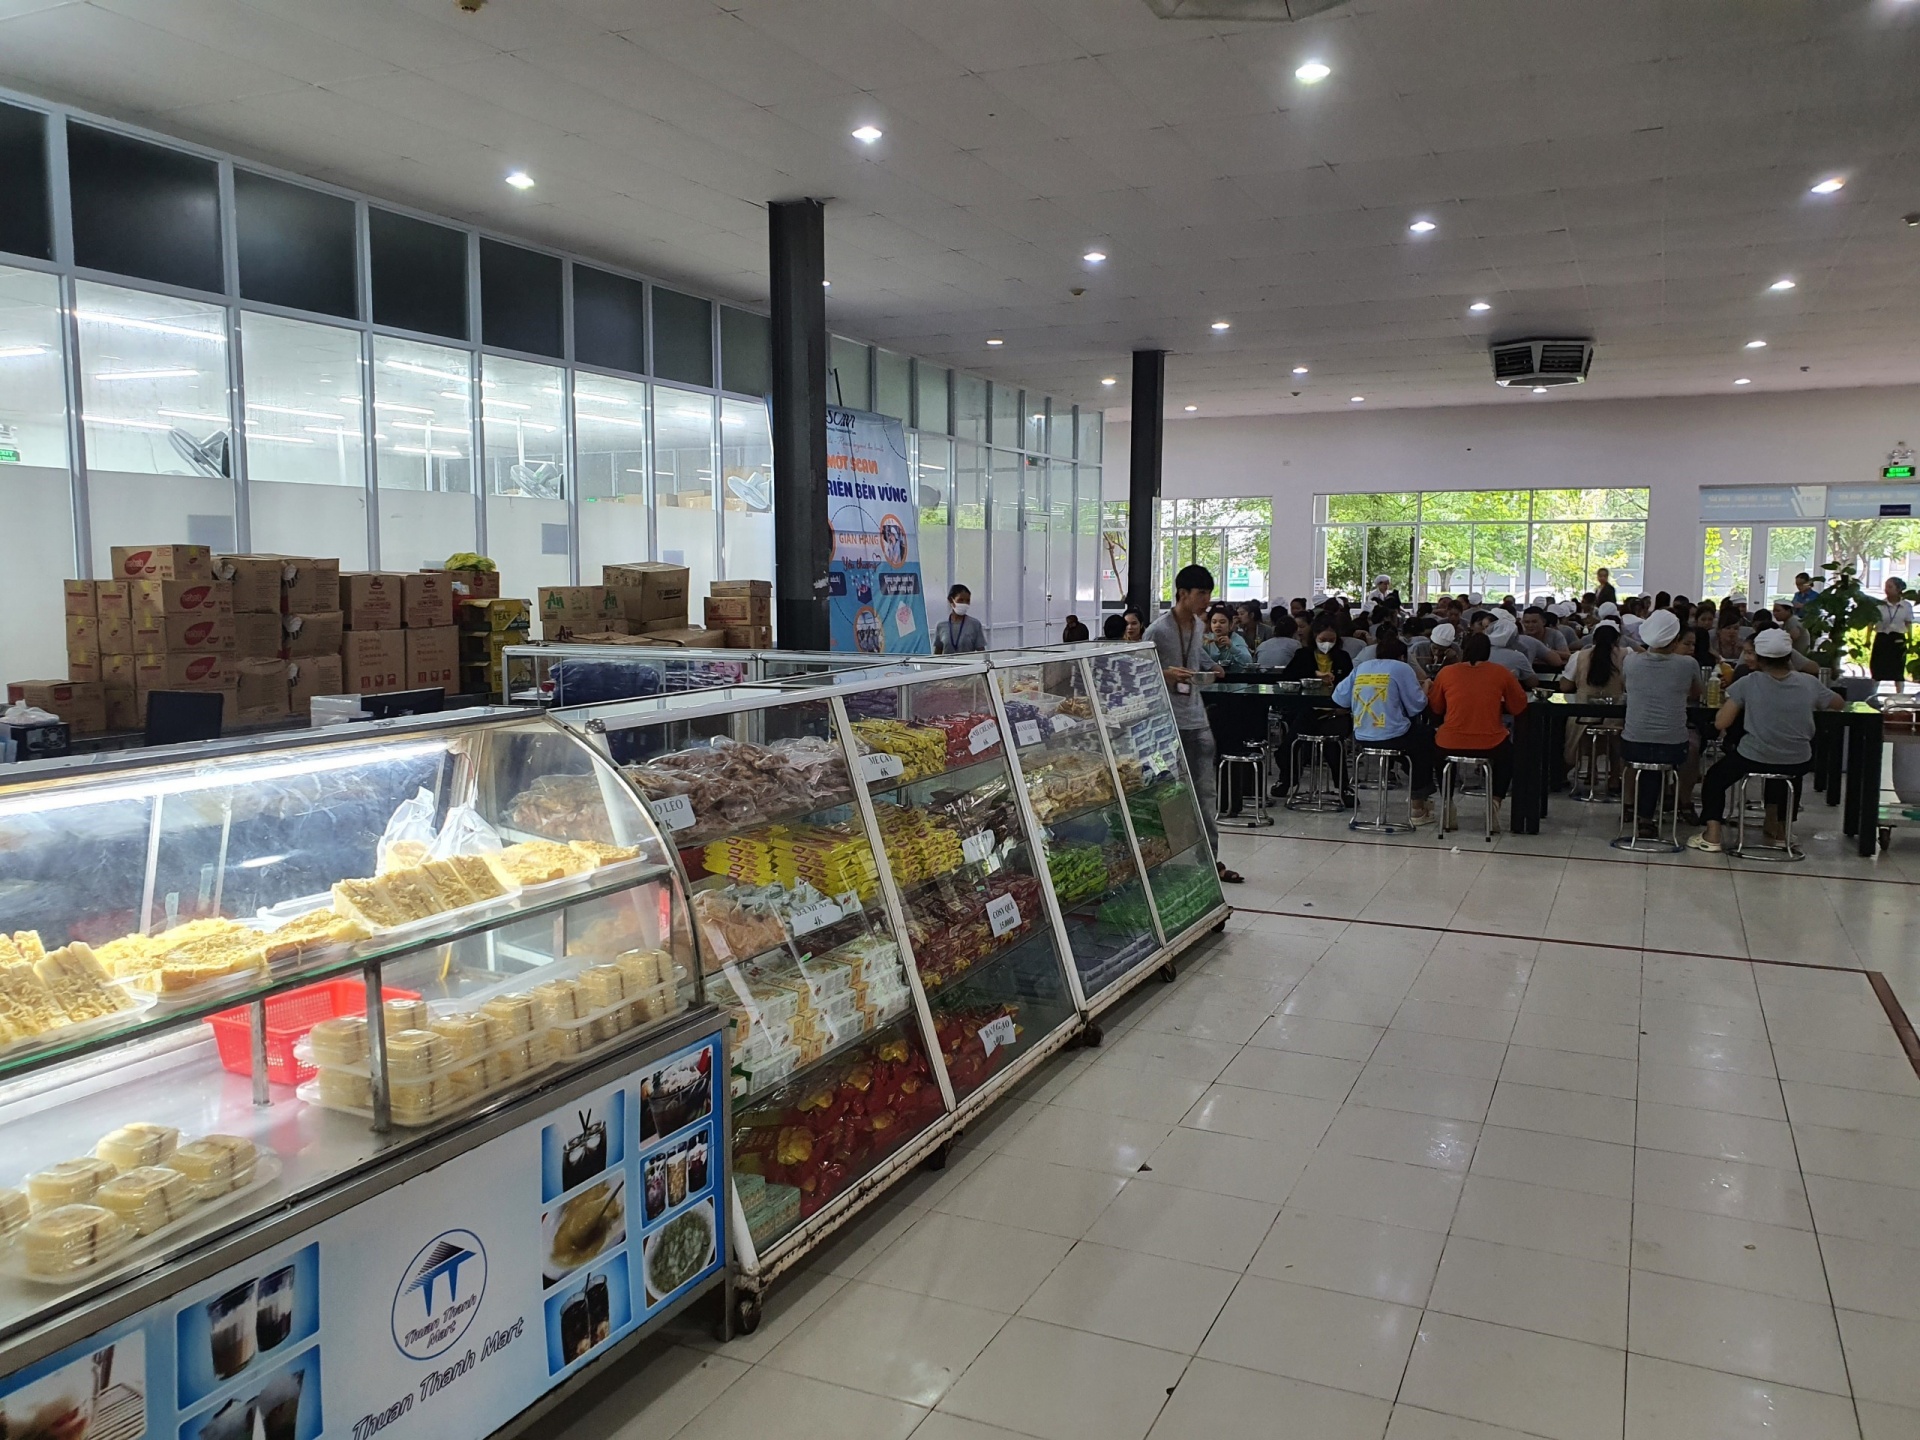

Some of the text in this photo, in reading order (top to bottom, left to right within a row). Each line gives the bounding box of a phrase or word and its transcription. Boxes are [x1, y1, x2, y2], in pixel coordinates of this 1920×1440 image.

[664, 819, 674, 830] K
[404, 1293, 477, 1348] Thuan Thanh
[427, 1320, 457, 1349] Mart
[352, 1316, 525, 1440] Thuan Thanh Mart
